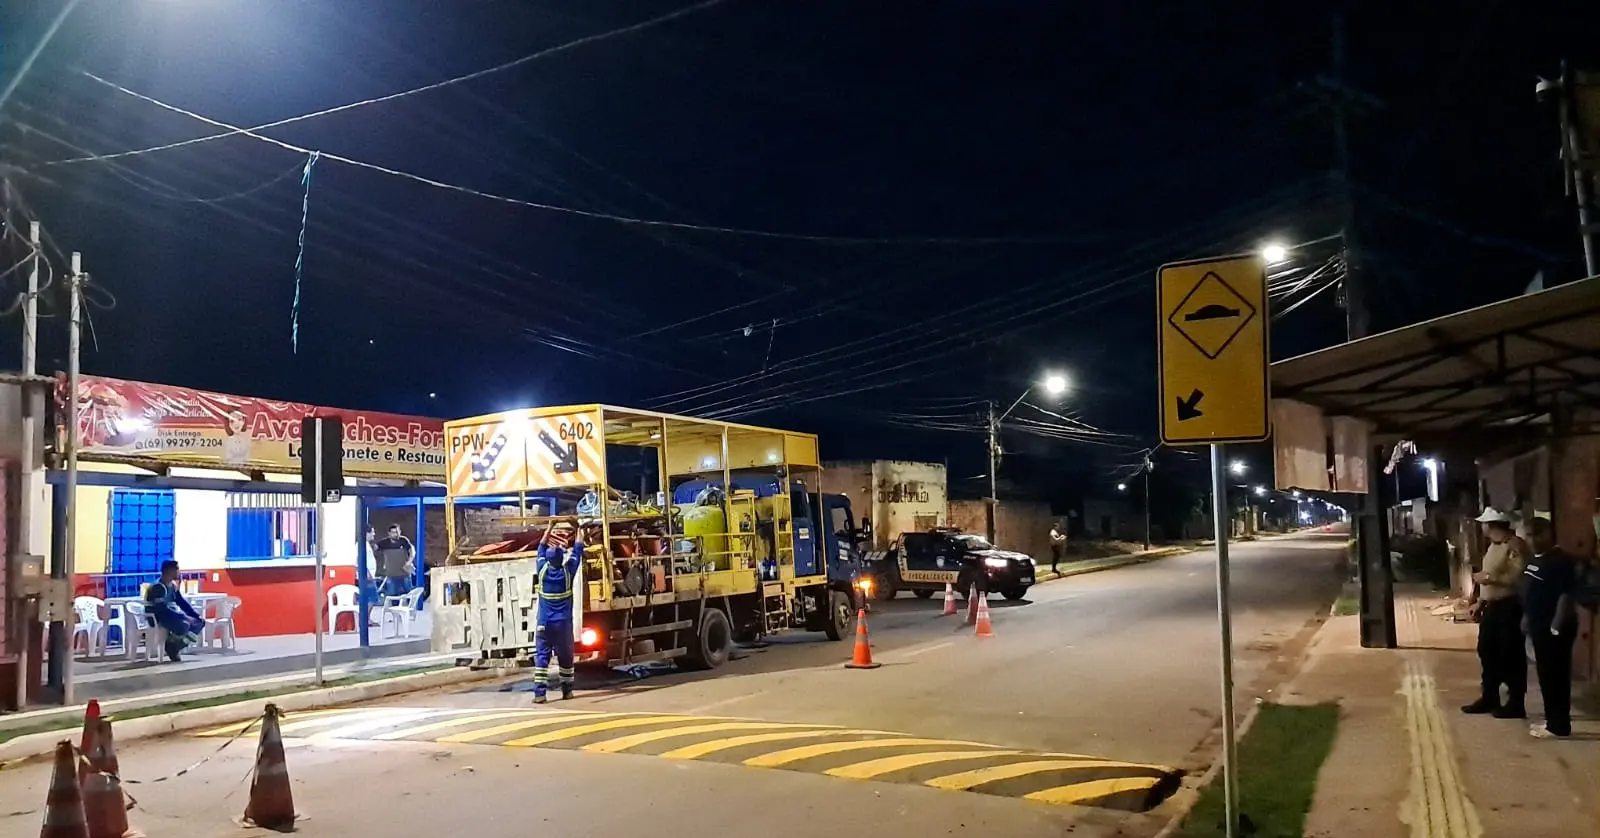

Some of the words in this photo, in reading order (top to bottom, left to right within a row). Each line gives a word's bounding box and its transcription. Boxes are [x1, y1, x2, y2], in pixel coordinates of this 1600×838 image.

[174, 429, 202, 438] Entrega
[251, 412, 445, 449] Avaches-For
[559, 422, 593, 440] 6402
[144, 438, 164, 449] (69)
[166, 438, 223, 448] 99297-2204
[288, 442, 379, 460] Laonete
[384, 449, 393, 461] e
